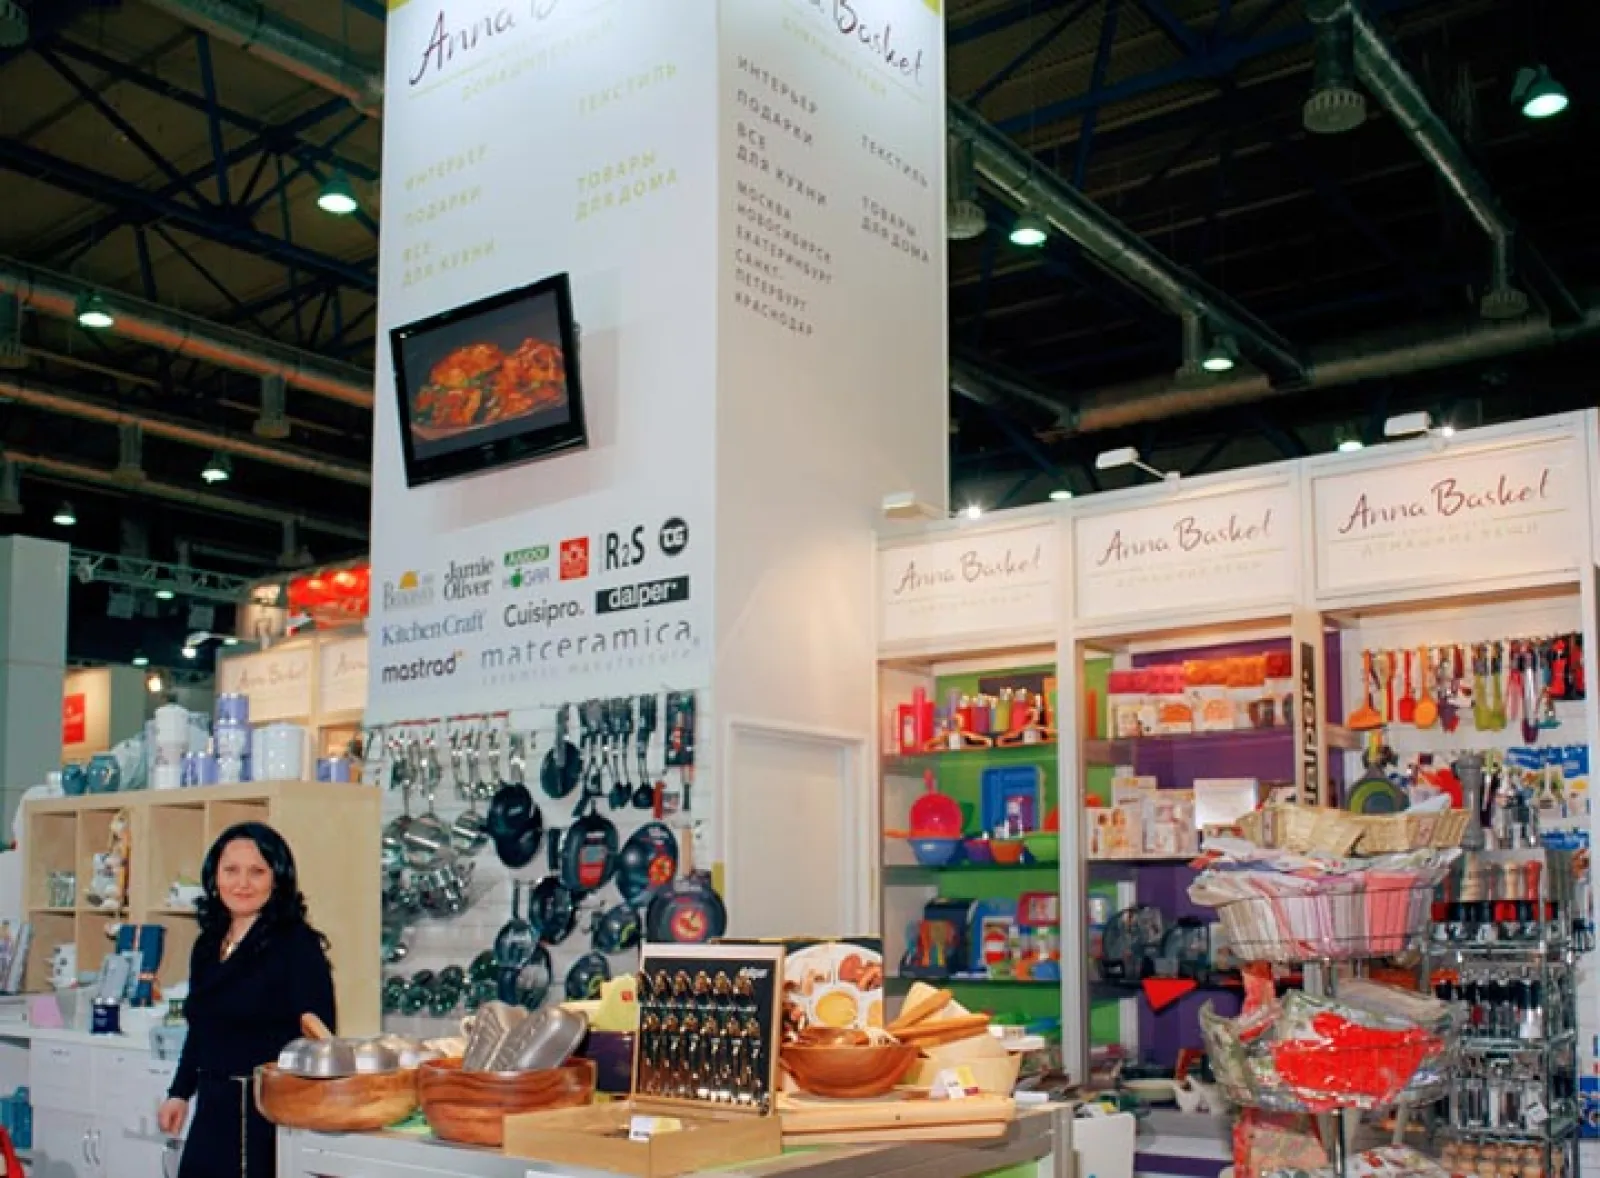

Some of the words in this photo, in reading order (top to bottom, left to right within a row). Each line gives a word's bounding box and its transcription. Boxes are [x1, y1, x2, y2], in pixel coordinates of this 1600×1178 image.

[409, 10, 516, 86] Anna
[738, 55, 818, 114] ИНТЕРЬЕР
[737, 121, 766, 150] ВСЕ
[738, 88, 812, 146] ПОДАРКИ
[576, 147, 656, 194] ТОВАРЫ
[737, 145, 770, 173] ДЛЯ
[776, 167, 827, 206] КУХНИ
[861, 134, 928, 189] ТЕКСТИЛЬ
[619, 167, 677, 206] ДОМА
[737, 180, 791, 222] МОСКВА
[737, 202, 832, 265] НОВОСИБИРСК
[861, 195, 916, 237] ТОВАРЫ
[736, 224, 832, 284] ЕКАТЕРИНБУРГ
[890, 232, 930, 264] ДОМА
[735, 267, 807, 312] ПЕТЕРБУРГ
[735, 291, 813, 335] КРАСНОДАР
[1337, 492, 1427, 534] Anna
[606, 524, 646, 570] R2S
[1096, 529, 1170, 567] Anna
[443, 576, 493, 602] Oliver
[444, 556, 494, 582] Jamie
[893, 560, 955, 595] Anna
[381, 652, 457, 685] mastrad
